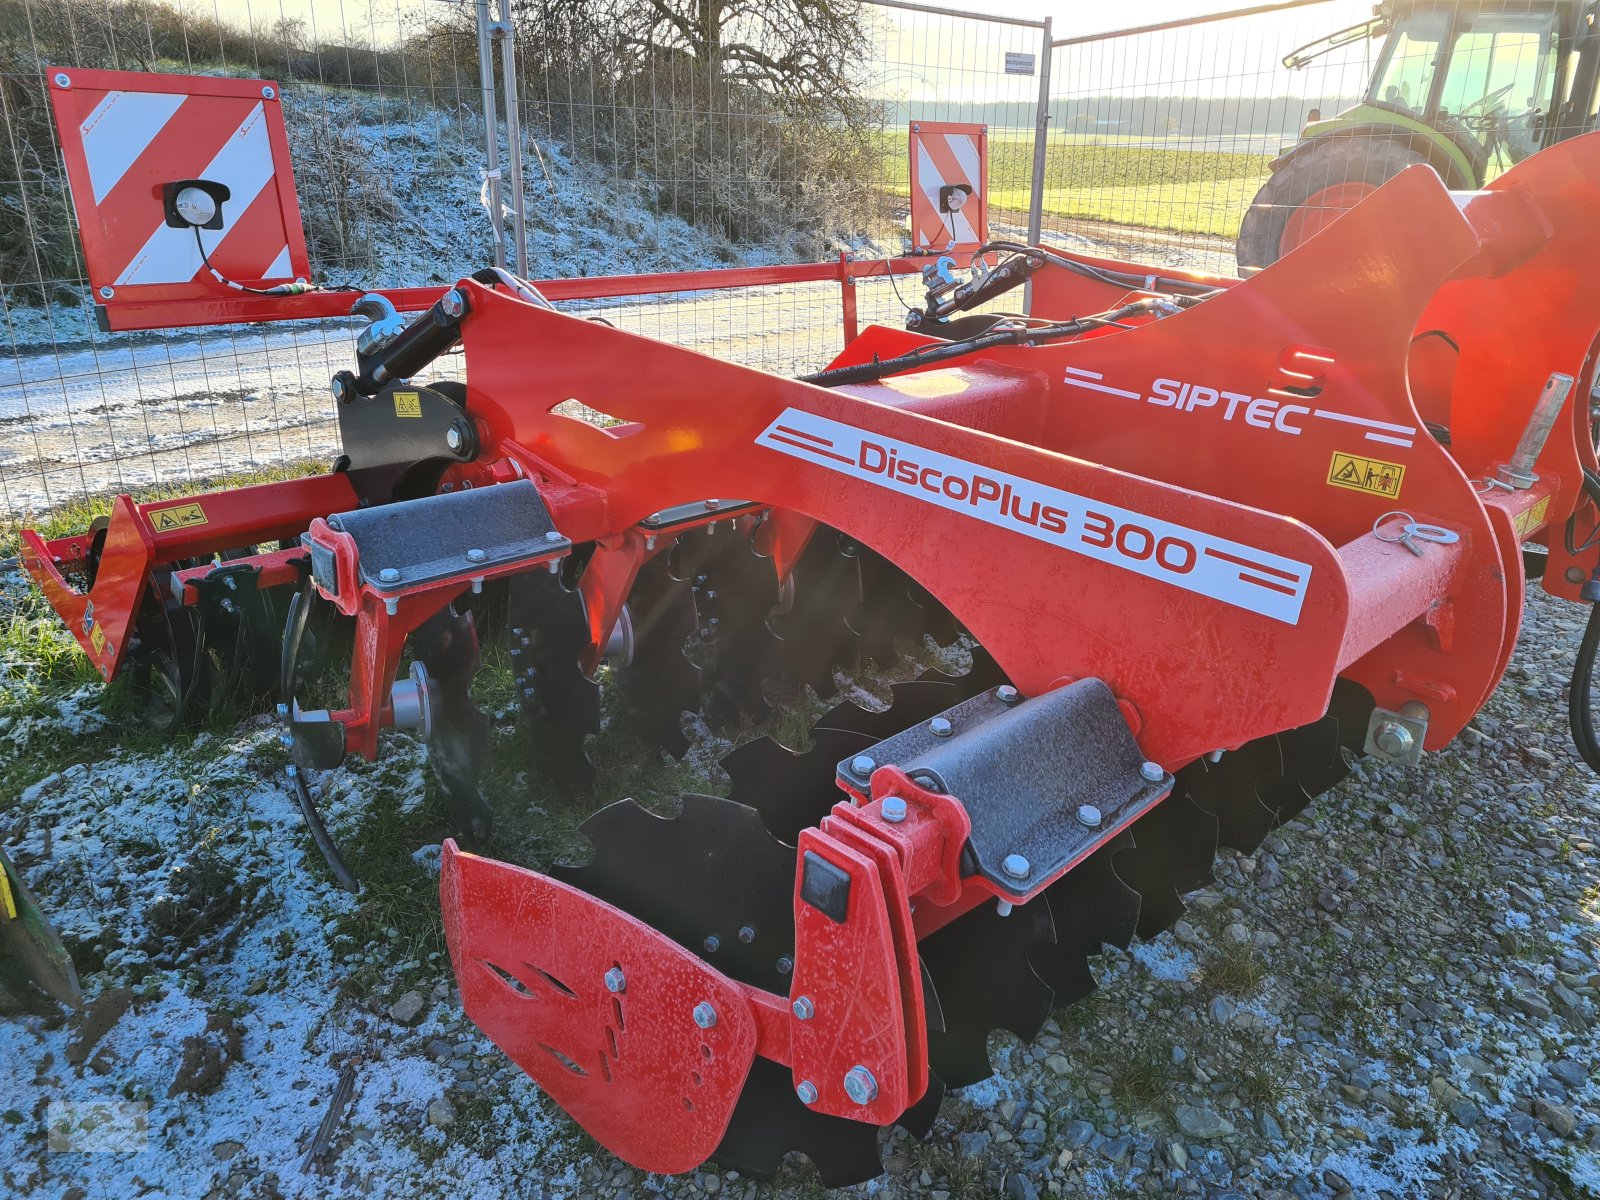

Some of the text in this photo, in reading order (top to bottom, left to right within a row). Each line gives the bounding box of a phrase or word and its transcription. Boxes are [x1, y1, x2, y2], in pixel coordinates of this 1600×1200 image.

[1147, 378, 1311, 435] SIPTEC
[858, 440, 1198, 575] DiscoPlus 300
